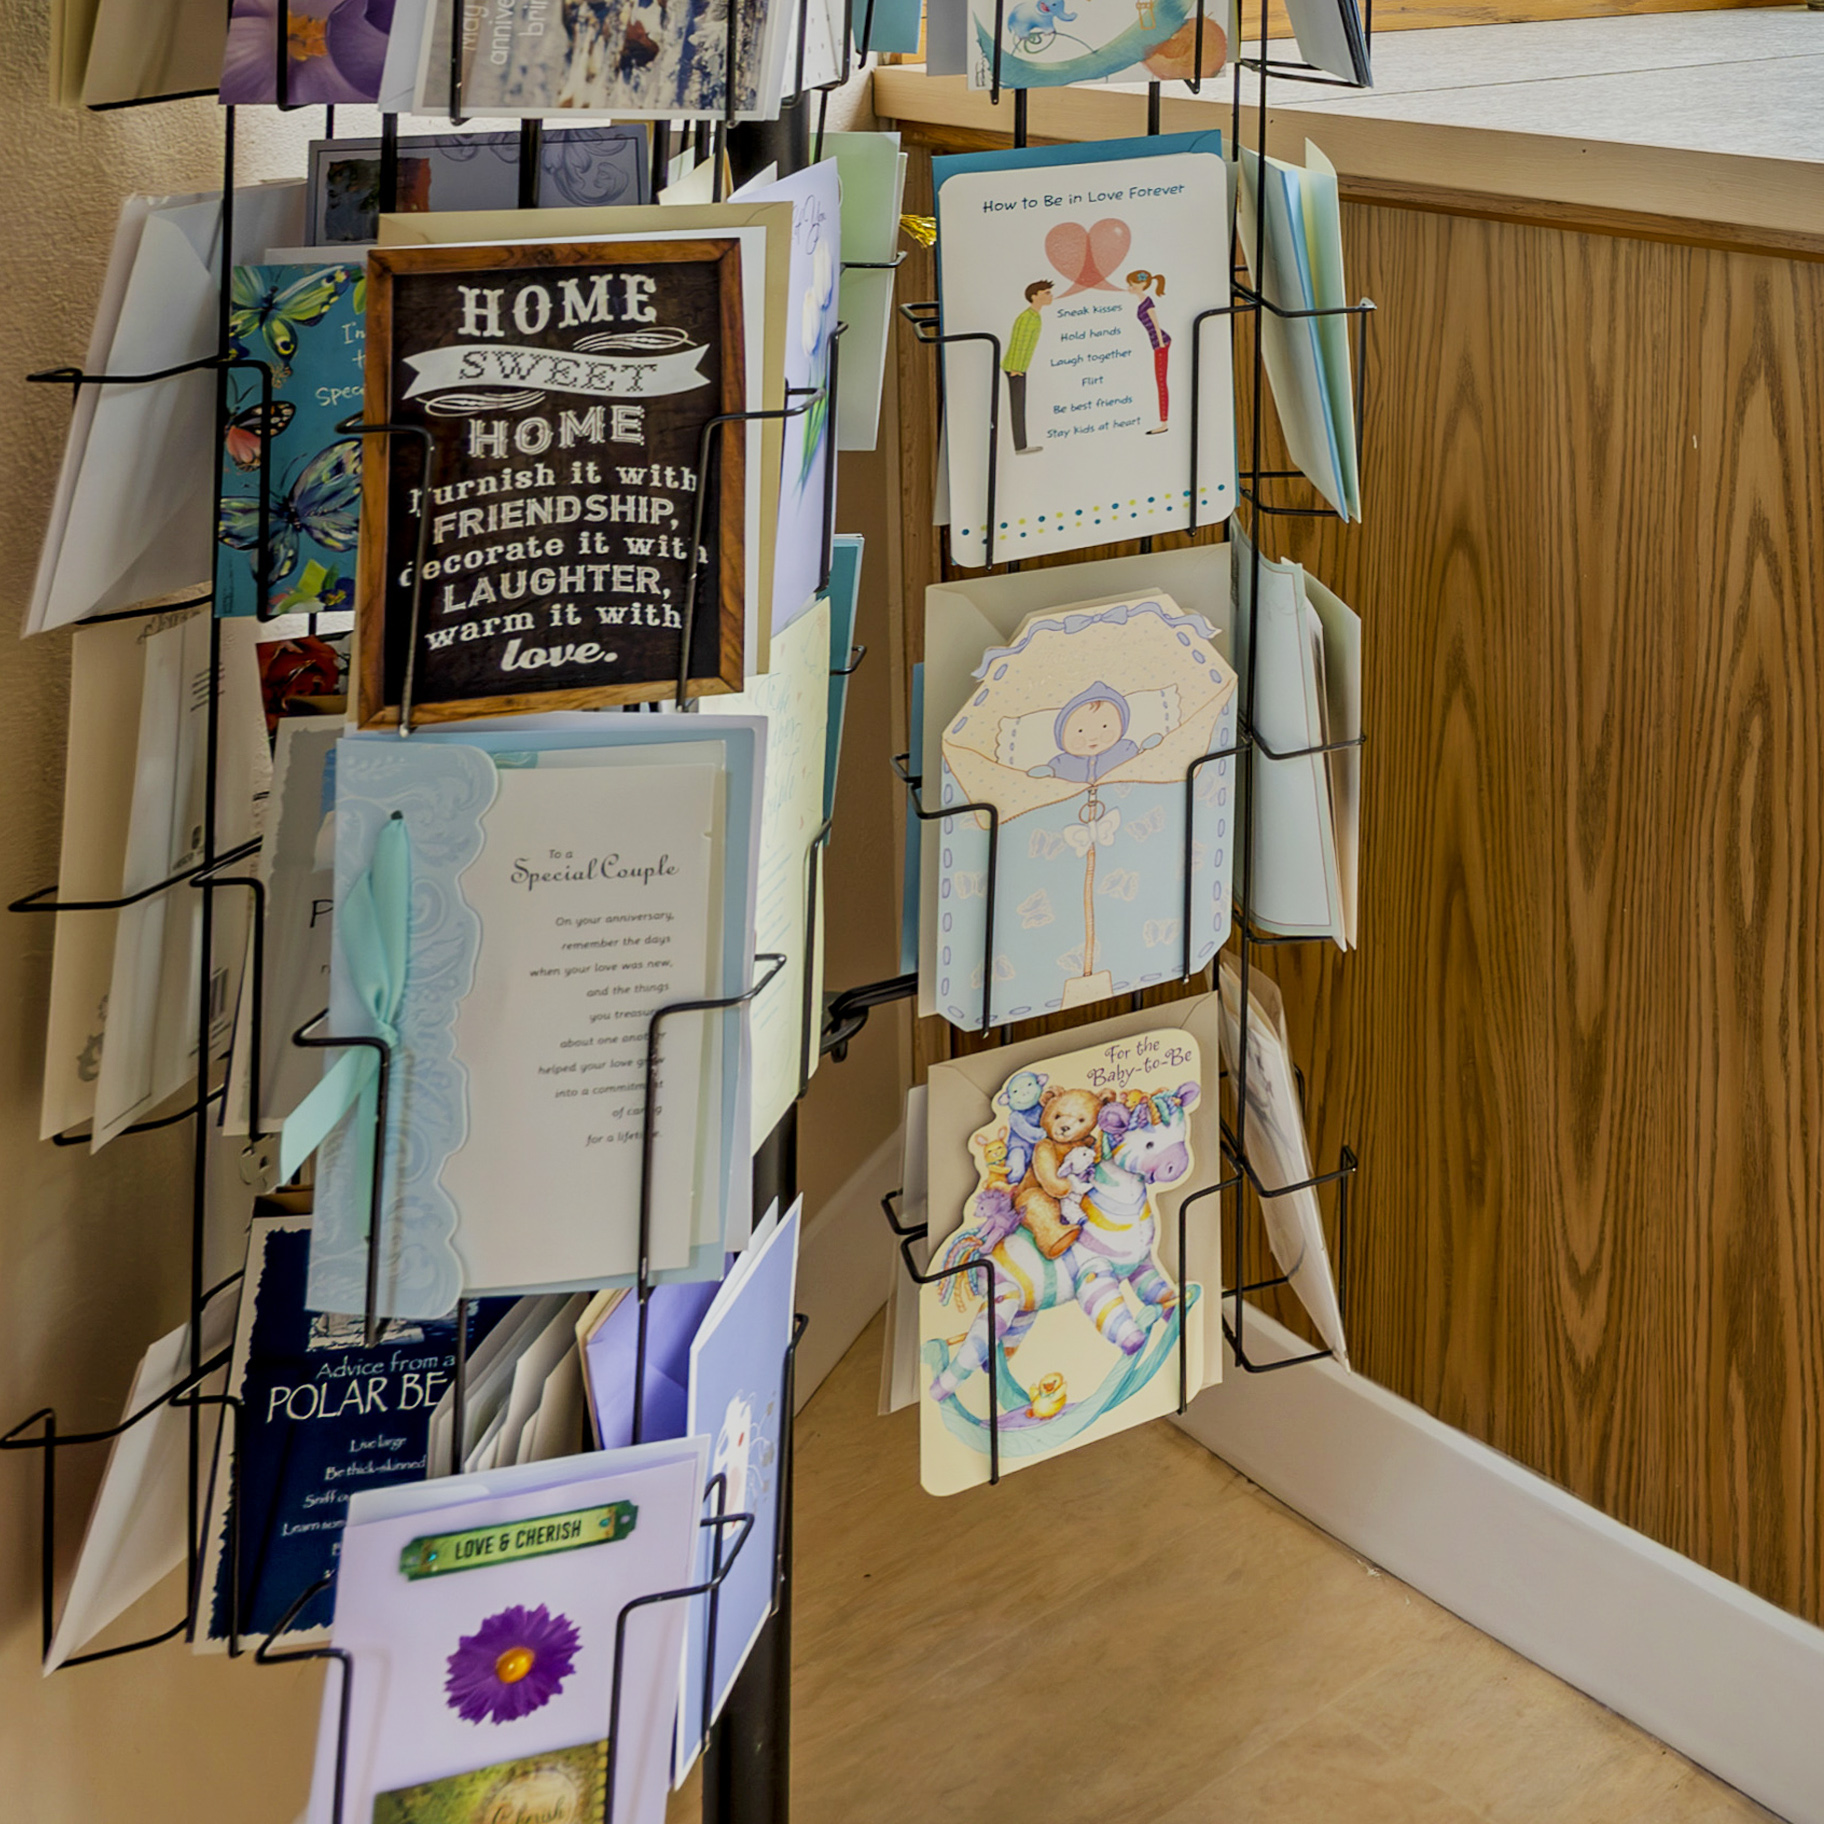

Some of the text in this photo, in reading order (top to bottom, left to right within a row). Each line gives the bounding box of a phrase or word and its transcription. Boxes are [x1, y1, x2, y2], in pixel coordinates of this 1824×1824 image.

[463, 6, 489, 51] May
[982, 183, 1186, 214] How to Be in Love Forever
[457, 273, 659, 338] HOME
[1057, 304, 1123, 318] Sneak kisses
[1060, 327, 1122, 342] Hold hands
[1050, 349, 1132, 367] Laugh together
[457, 348, 660, 394] SWEET
[1081, 376, 1104, 387] Flirt
[1053, 395, 1133, 414] Be best friends
[468, 404, 646, 460] HOME
[1046, 417, 1141, 439] Stay kids at heart
[570, 461, 699, 493] it with
[432, 495, 680, 546] FRIENDSHIP,
[578, 532, 610, 555] it
[442, 564, 674, 615] LAUGHTER,
[424, 602, 684, 651] warm it with
[500, 639, 619, 672] love.
[549, 849, 573, 859] To a
[510, 853, 680, 891] Special Couple
[555, 917, 572, 926] On
[576, 917, 601, 928] your
[561, 935, 671, 950] remember the days
[529, 967, 560, 977] when
[564, 966, 591, 978] your
[595, 963, 618, 972] love
[622, 962, 643, 970] was
[586, 982, 669, 997] and the things
[589, 1013, 611, 1023] you
[560, 1036, 618, 1048] about one
[1104, 1037, 1162, 1063] For the
[538, 1059, 633, 1075] helped your love
[1086, 1047, 1193, 1088] Baby-to-Be
[555, 1087, 589, 1098] into a
[612, 1107, 624, 1119] of
[585, 1134, 614, 1147] for a
[315, 1350, 456, 1380] Advice from a
[266, 1377, 389, 1424] POLAR
[350, 1438, 377, 1453] Live
[325, 1466, 343, 1481] Be
[454, 1518, 584, 1561] LOVE & CHERISH
